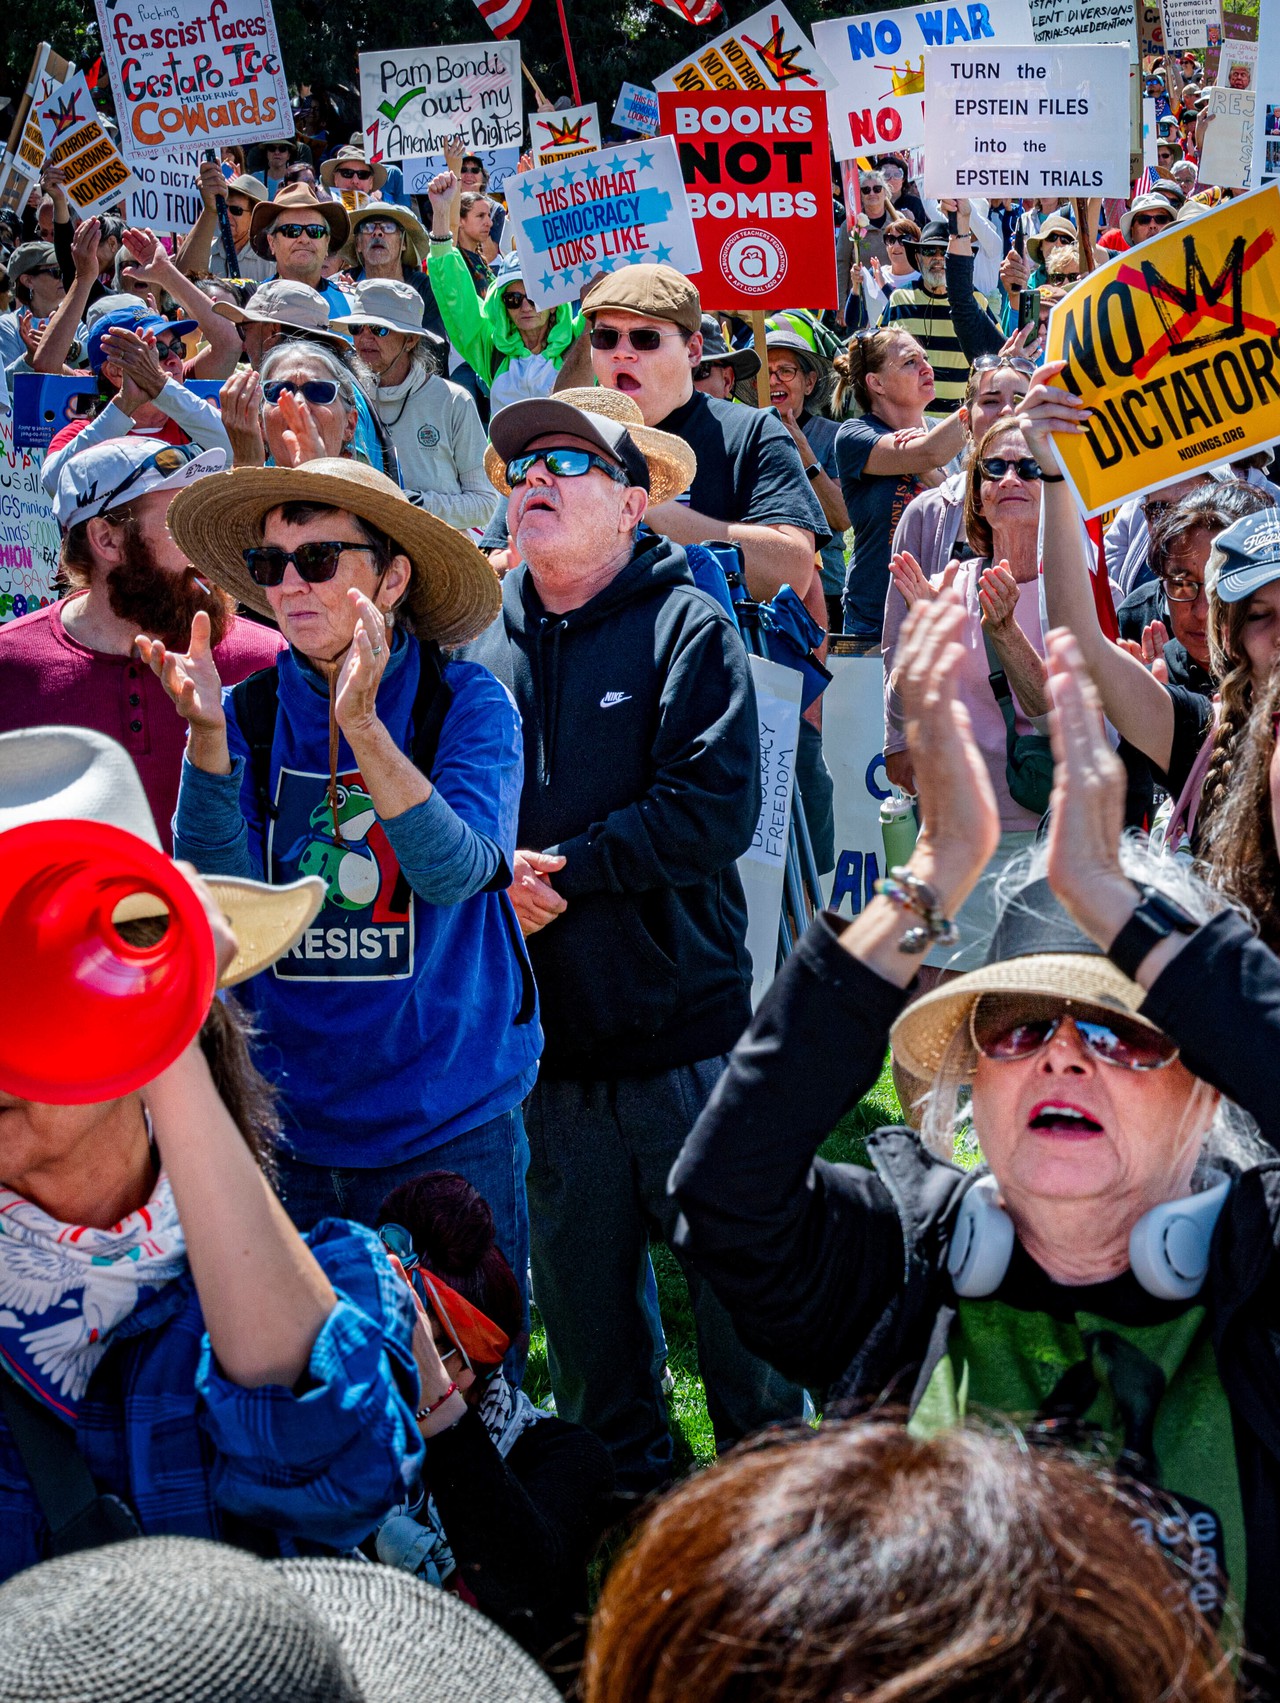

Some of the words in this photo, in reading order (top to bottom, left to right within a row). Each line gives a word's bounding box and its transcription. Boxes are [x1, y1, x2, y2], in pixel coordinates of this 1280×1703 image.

[113, 13, 207, 55] fascist
[207, 0, 267, 42] faces
[138, 4, 179, 22] fucking
[1067, 4, 1134, 23] DIVERSIONS
[1164, 8, 1218, 18] Authoritarian
[1165, 18, 1208, 28] Vindictive
[847, 19, 902, 61] NO
[916, 2, 995, 46] WAR
[1167, 27, 1201, 37] Election
[1172, 37, 1190, 48] ACT
[141, 51, 154, 59] you
[700, 51, 724, 77] NO
[721, 39, 744, 62] NO
[381, 60, 432, 93] Pam
[437, 51, 506, 83] Bondi
[950, 63, 1001, 80] TURN
[1016, 63, 1047, 79] the
[180, 89, 239, 105] MURDERING
[421, 93, 472, 118] out
[480, 86, 513, 120] my
[955, 99, 1029, 116] EPSTEIN
[1038, 98, 1089, 115] FILES
[471, 117, 522, 148] Rights
[675, 105, 813, 134] BOOKS
[847, 107, 903, 148] NO
[64, 123, 102, 156] THRONES
[974, 136, 1008, 153] into
[1022, 139, 1047, 153] the
[76, 140, 114, 173] CROWNS
[679, 141, 813, 185] NOT
[71, 180, 94, 205] NO
[92, 160, 128, 193] KINGS
[132, 166, 156, 183] NO
[955, 168, 1030, 186] EPSTEIN
[1039, 170, 1104, 187] TRIALS
[132, 190, 158, 219] NO
[536, 184, 569, 217] THIS
[568, 181, 586, 206] IS
[586, 170, 638, 202] WHAT
[688, 191, 818, 219] BOMBS
[542, 196, 643, 244] DEMOCRACY
[548, 233, 598, 272] LOOKS
[599, 223, 650, 258] LIKE
[721, 234, 741, 274] ALBUQUERQUE
[740, 230, 771, 241] TEACHERS
[769, 237, 786, 273] FEDERATION
[1060, 279, 1147, 397] NO
[1177, 426, 1246, 462] NOKINGS.ORG
[895, 484, 908, 497] IS
[890, 500, 904, 526] ONE
[604, 691, 625, 702] NIKE
[765, 748, 794, 858] FREEDOM
[280, 927, 405, 960] RESIST
